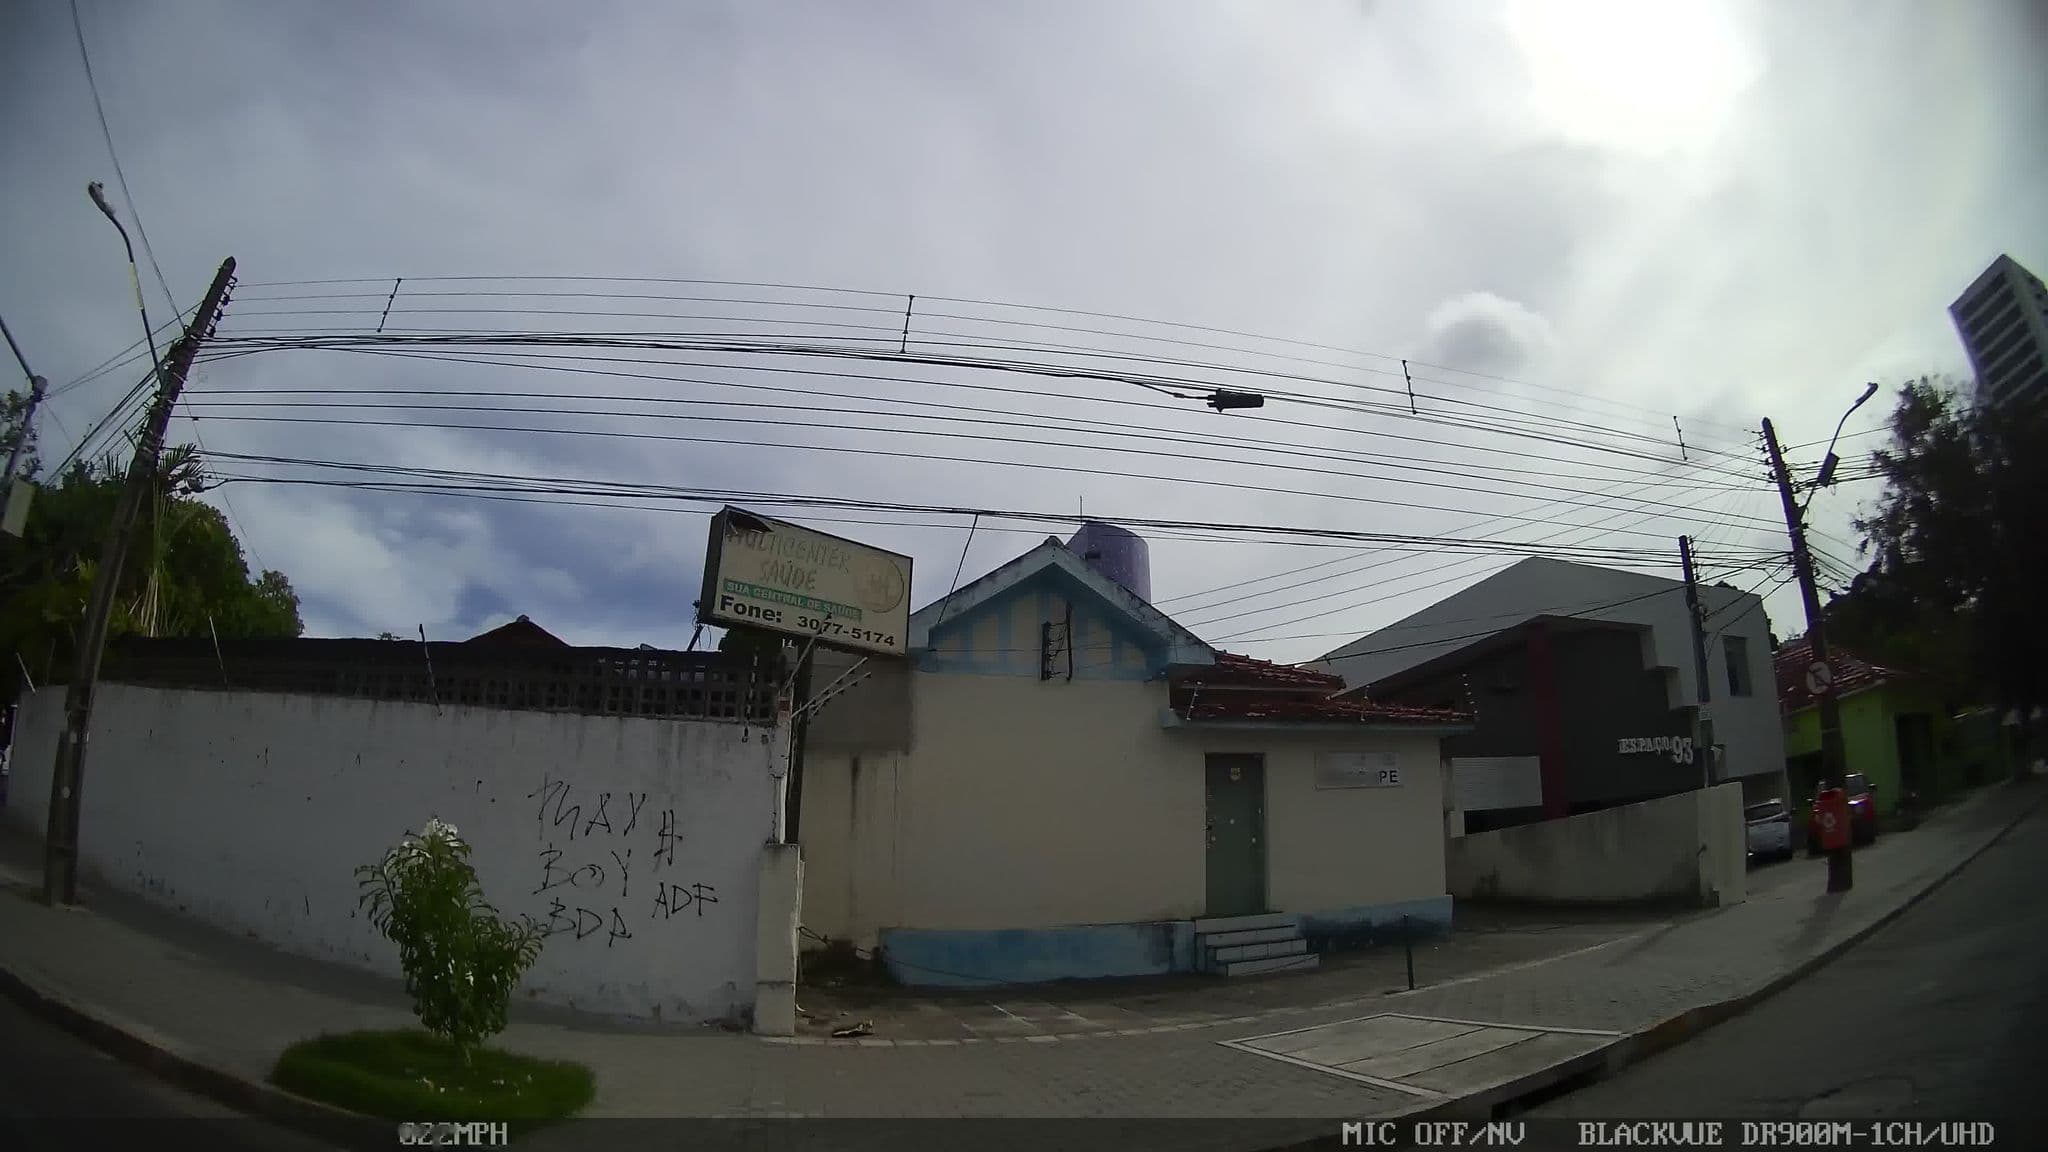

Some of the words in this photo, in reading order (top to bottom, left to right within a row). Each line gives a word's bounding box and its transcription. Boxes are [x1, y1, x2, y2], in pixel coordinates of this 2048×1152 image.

[725, 582, 751, 595] SUA
[753, 586, 804, 607] CENTRAL
[807, 598, 822, 611] DE
[720, 594, 782, 623] Fone:
[797, 616, 895, 647] 3077-5174
[1618, 736, 1670, 755] ESPAÇO
[1672, 736, 1694, 764] 93
